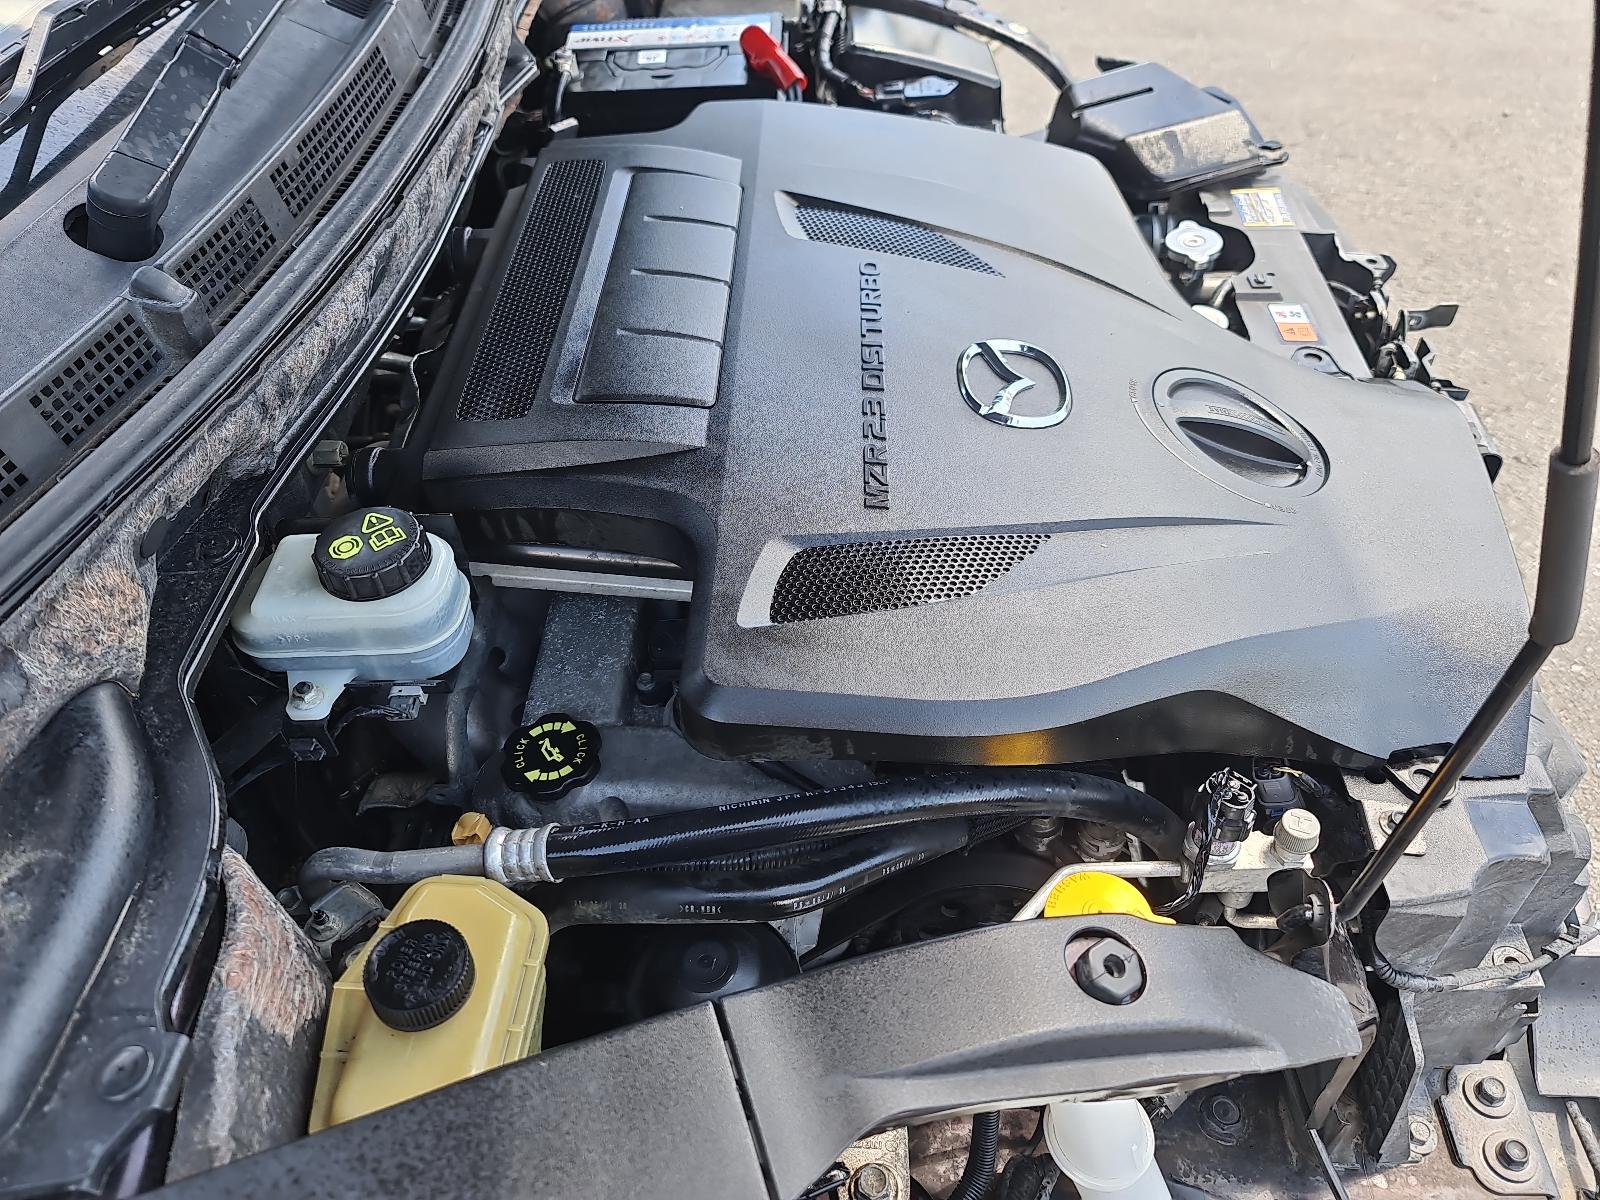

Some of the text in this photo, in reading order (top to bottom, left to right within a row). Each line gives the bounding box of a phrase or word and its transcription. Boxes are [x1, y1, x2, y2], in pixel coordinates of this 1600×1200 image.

[858, 259, 883, 337] TURBO
[860, 340, 885, 391] DISI
[863, 443, 889, 510] MZR
[513, 737, 530, 769] CLICK
[572, 733, 588, 765] CLICK
[718, 798, 771, 813] NICHIRIN
